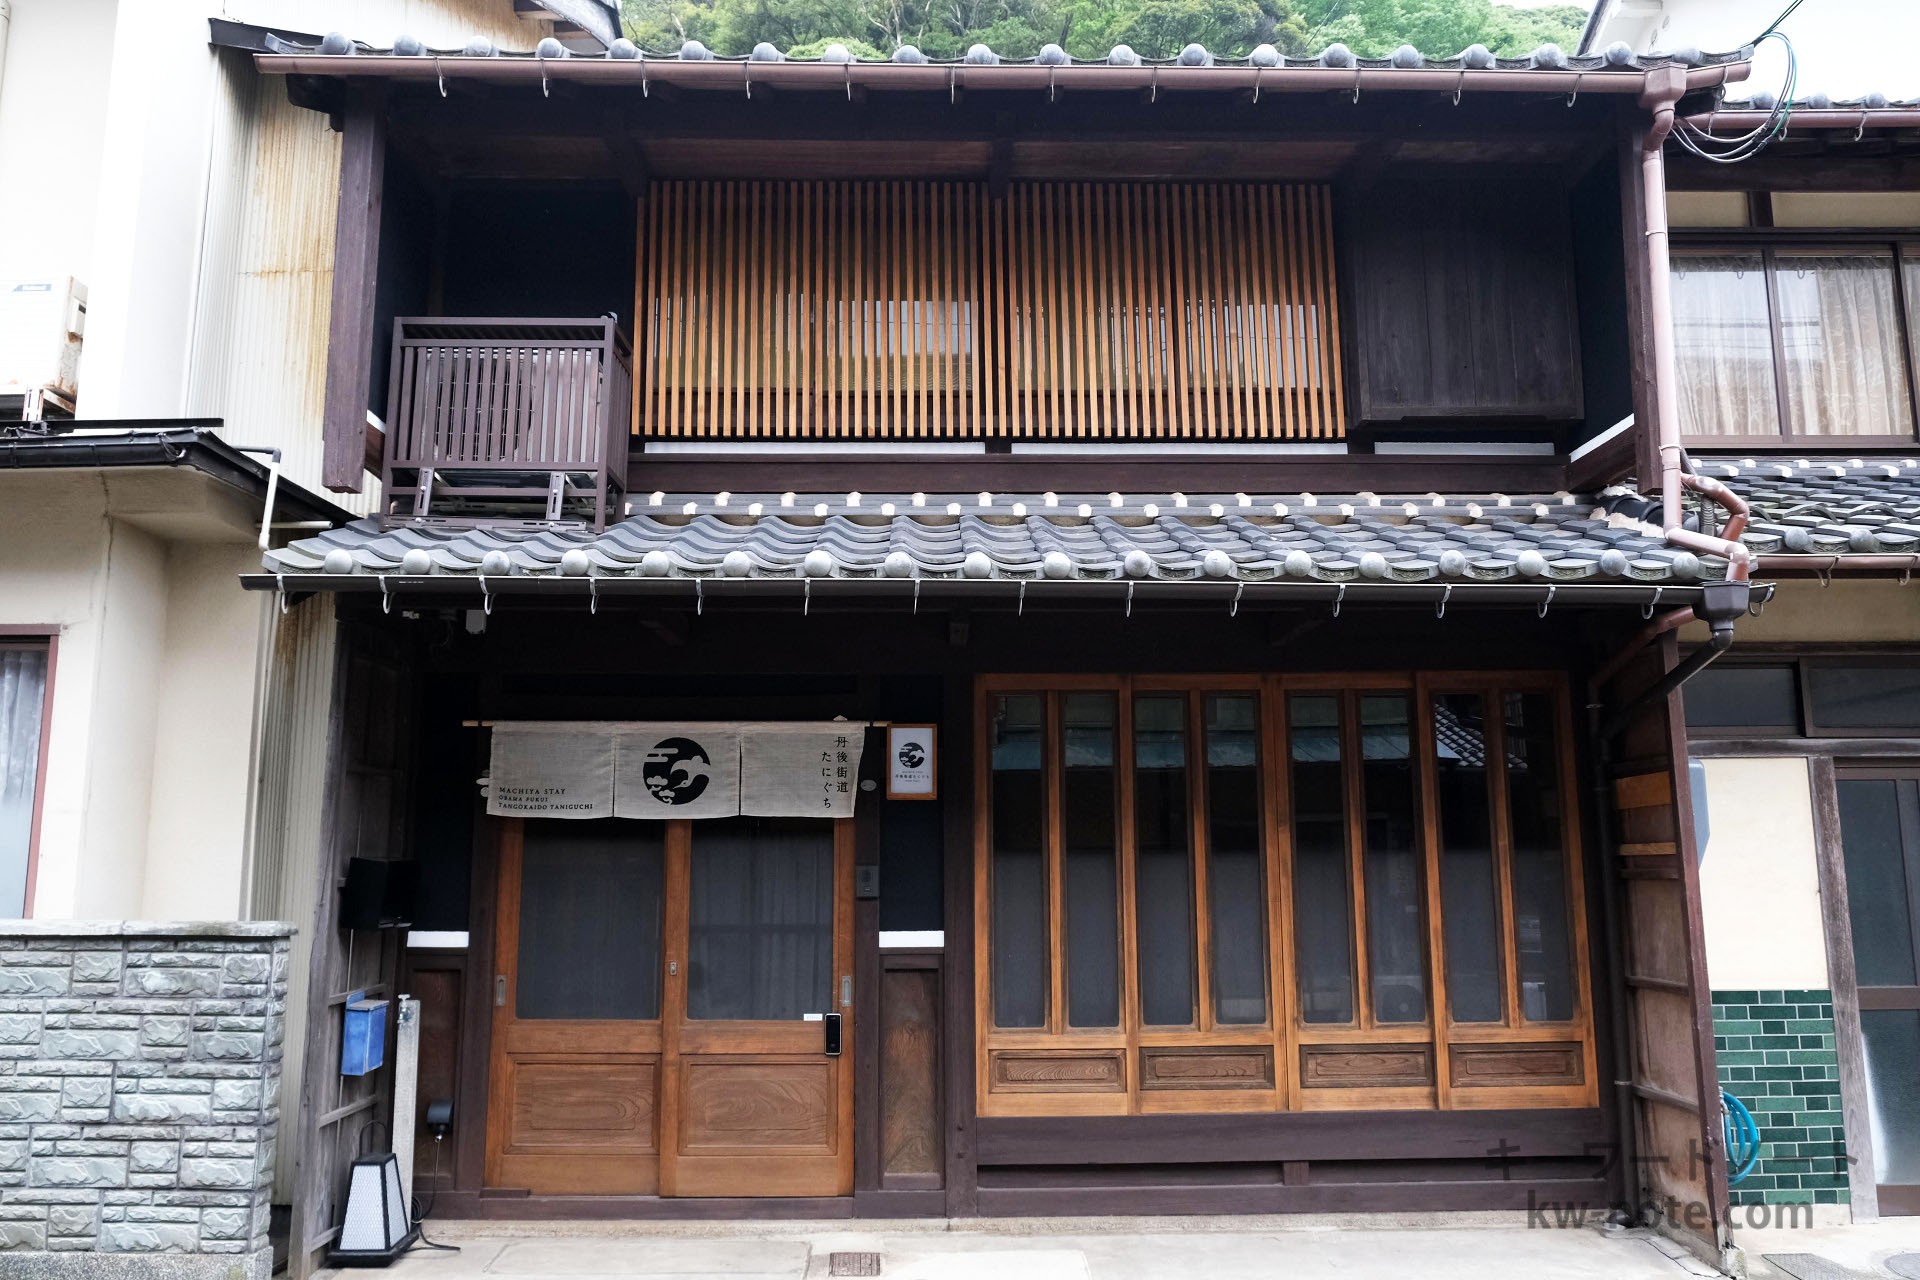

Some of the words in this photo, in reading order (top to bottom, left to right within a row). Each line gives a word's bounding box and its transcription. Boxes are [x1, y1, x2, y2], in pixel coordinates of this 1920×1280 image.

[499, 787, 540, 795] MACHIYA
[822, 751, 832, 808] たにぐち
[834, 736, 848, 793] 丹後街道
